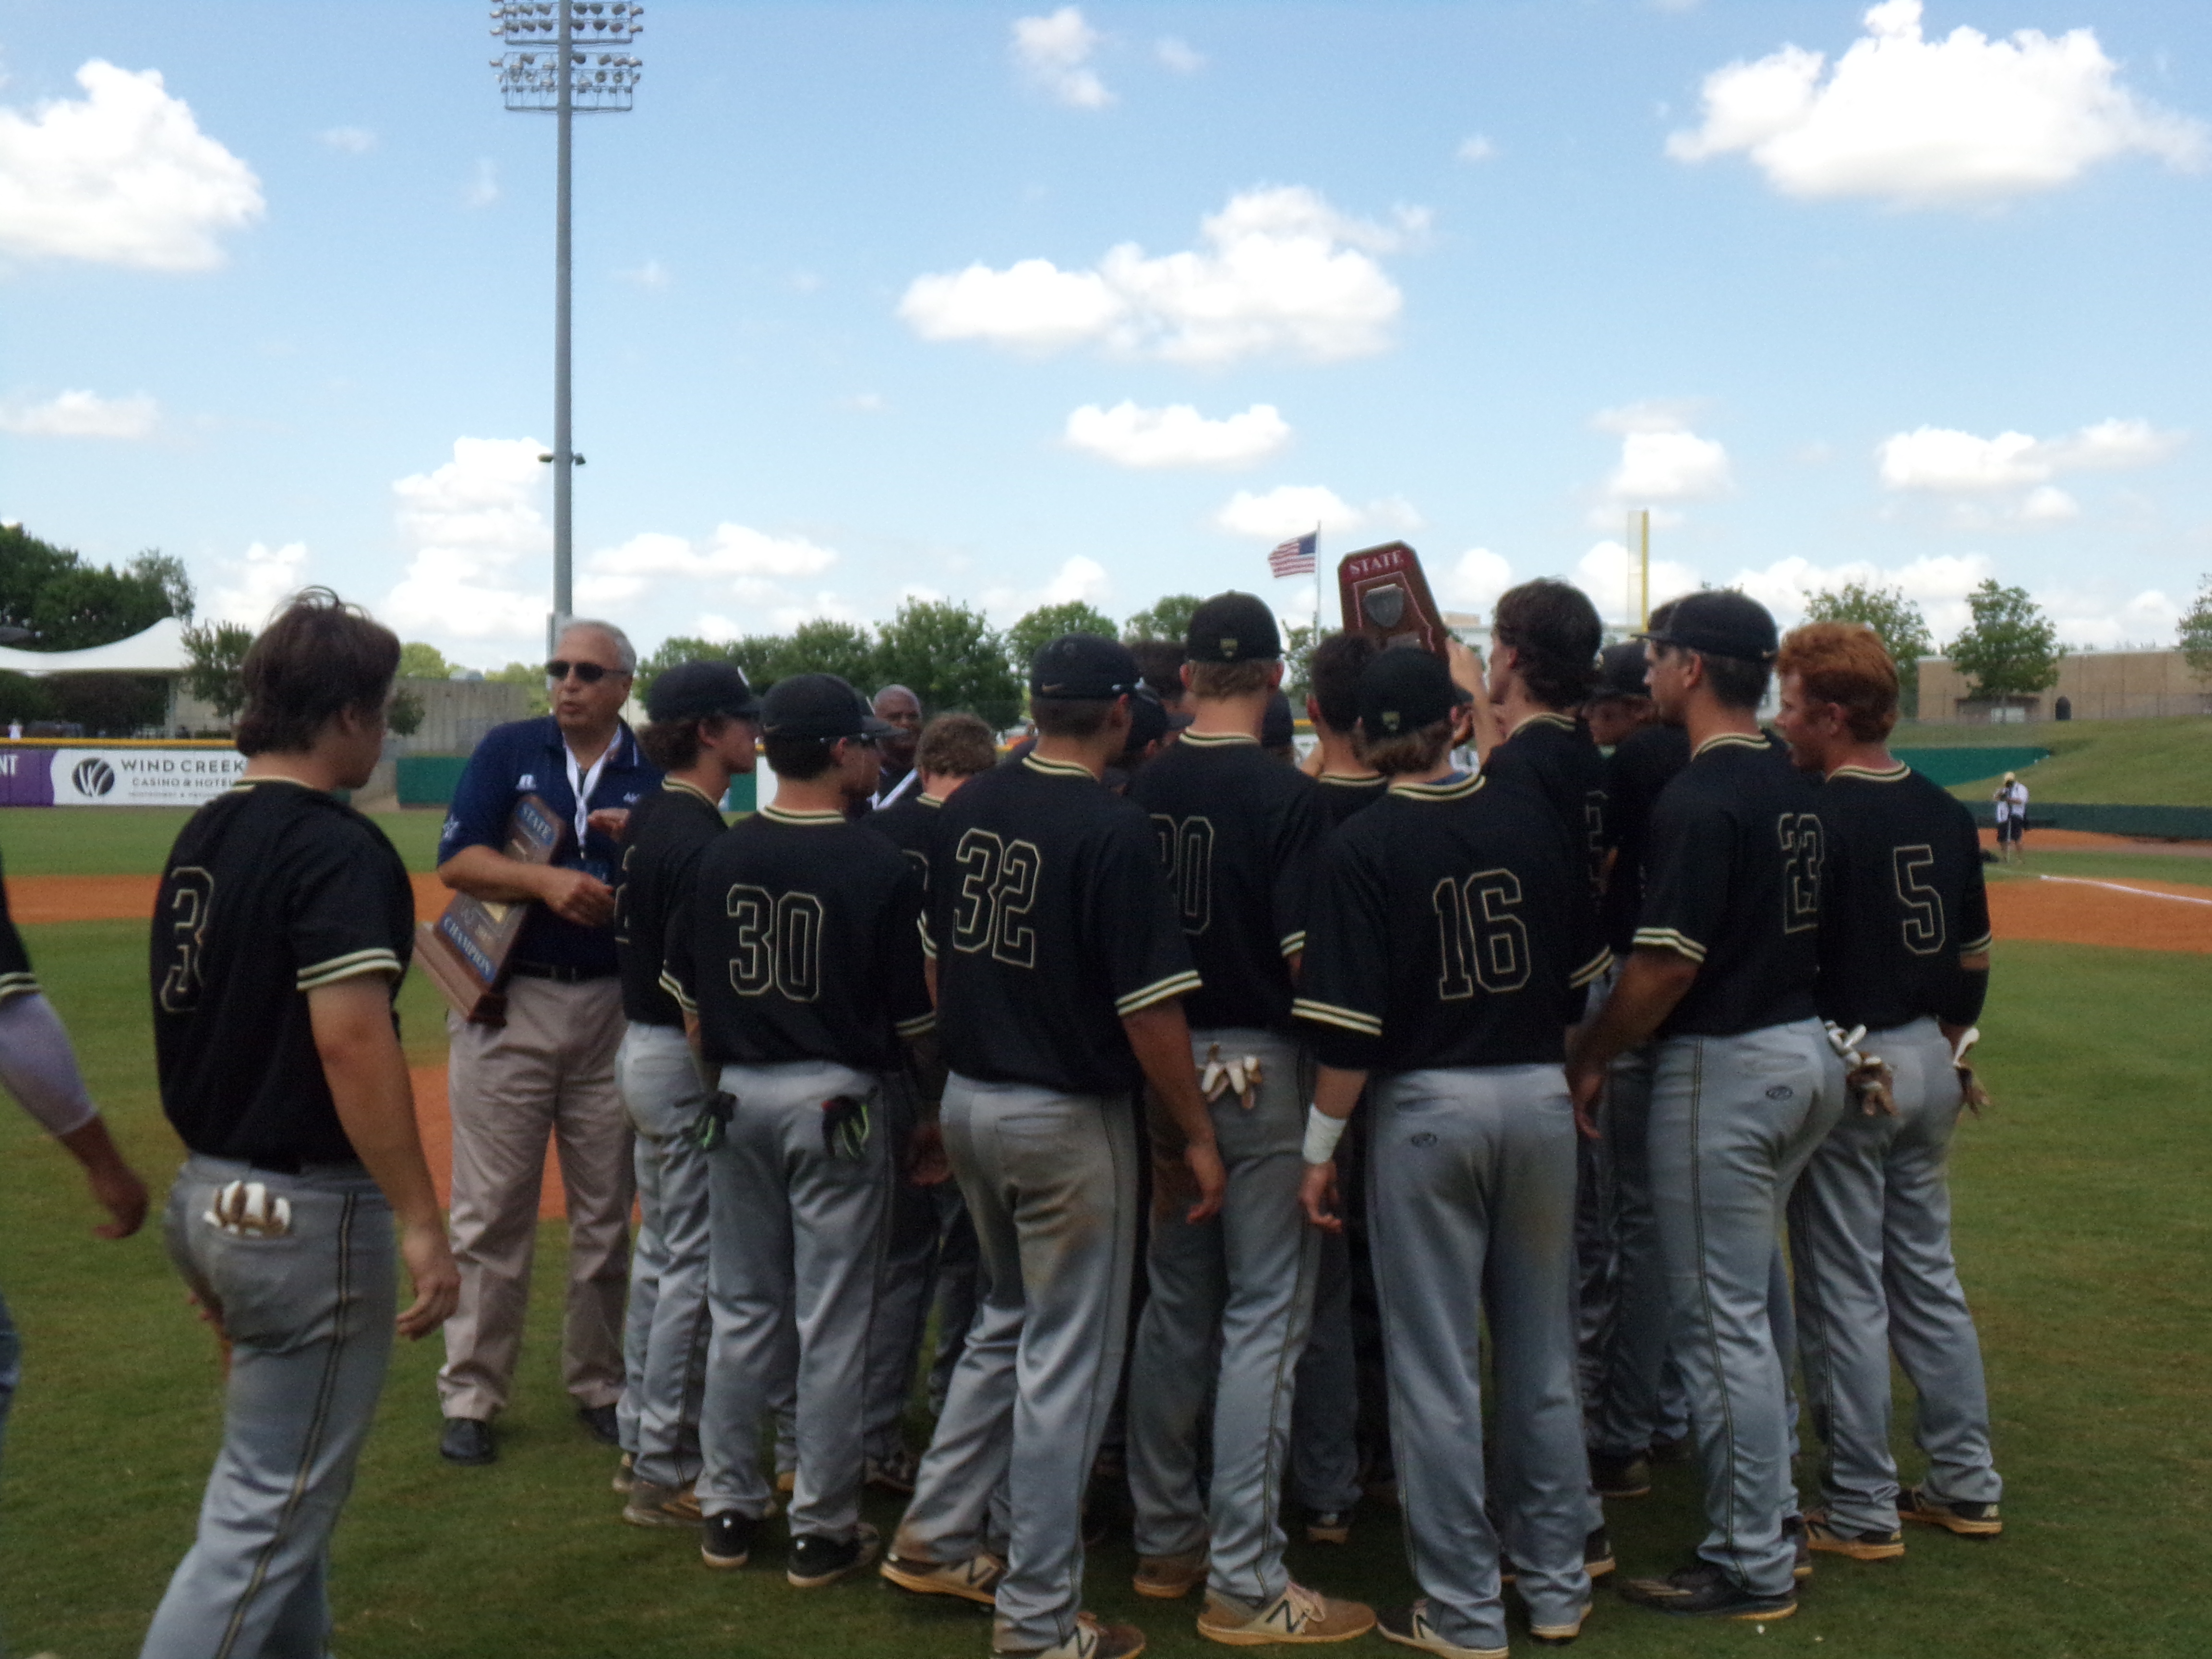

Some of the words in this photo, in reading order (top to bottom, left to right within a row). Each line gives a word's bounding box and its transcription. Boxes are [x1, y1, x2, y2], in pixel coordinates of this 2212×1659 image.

[120, 759, 174, 772] WIND
[180, 759, 243, 773] CREEK
[132, 778, 180, 786] CASINO
[726, 883, 824, 1002] 30
[952, 827, 1041, 969] 32
[1433, 867, 1531, 1000] 16
[1893, 843, 1946, 955] 5
